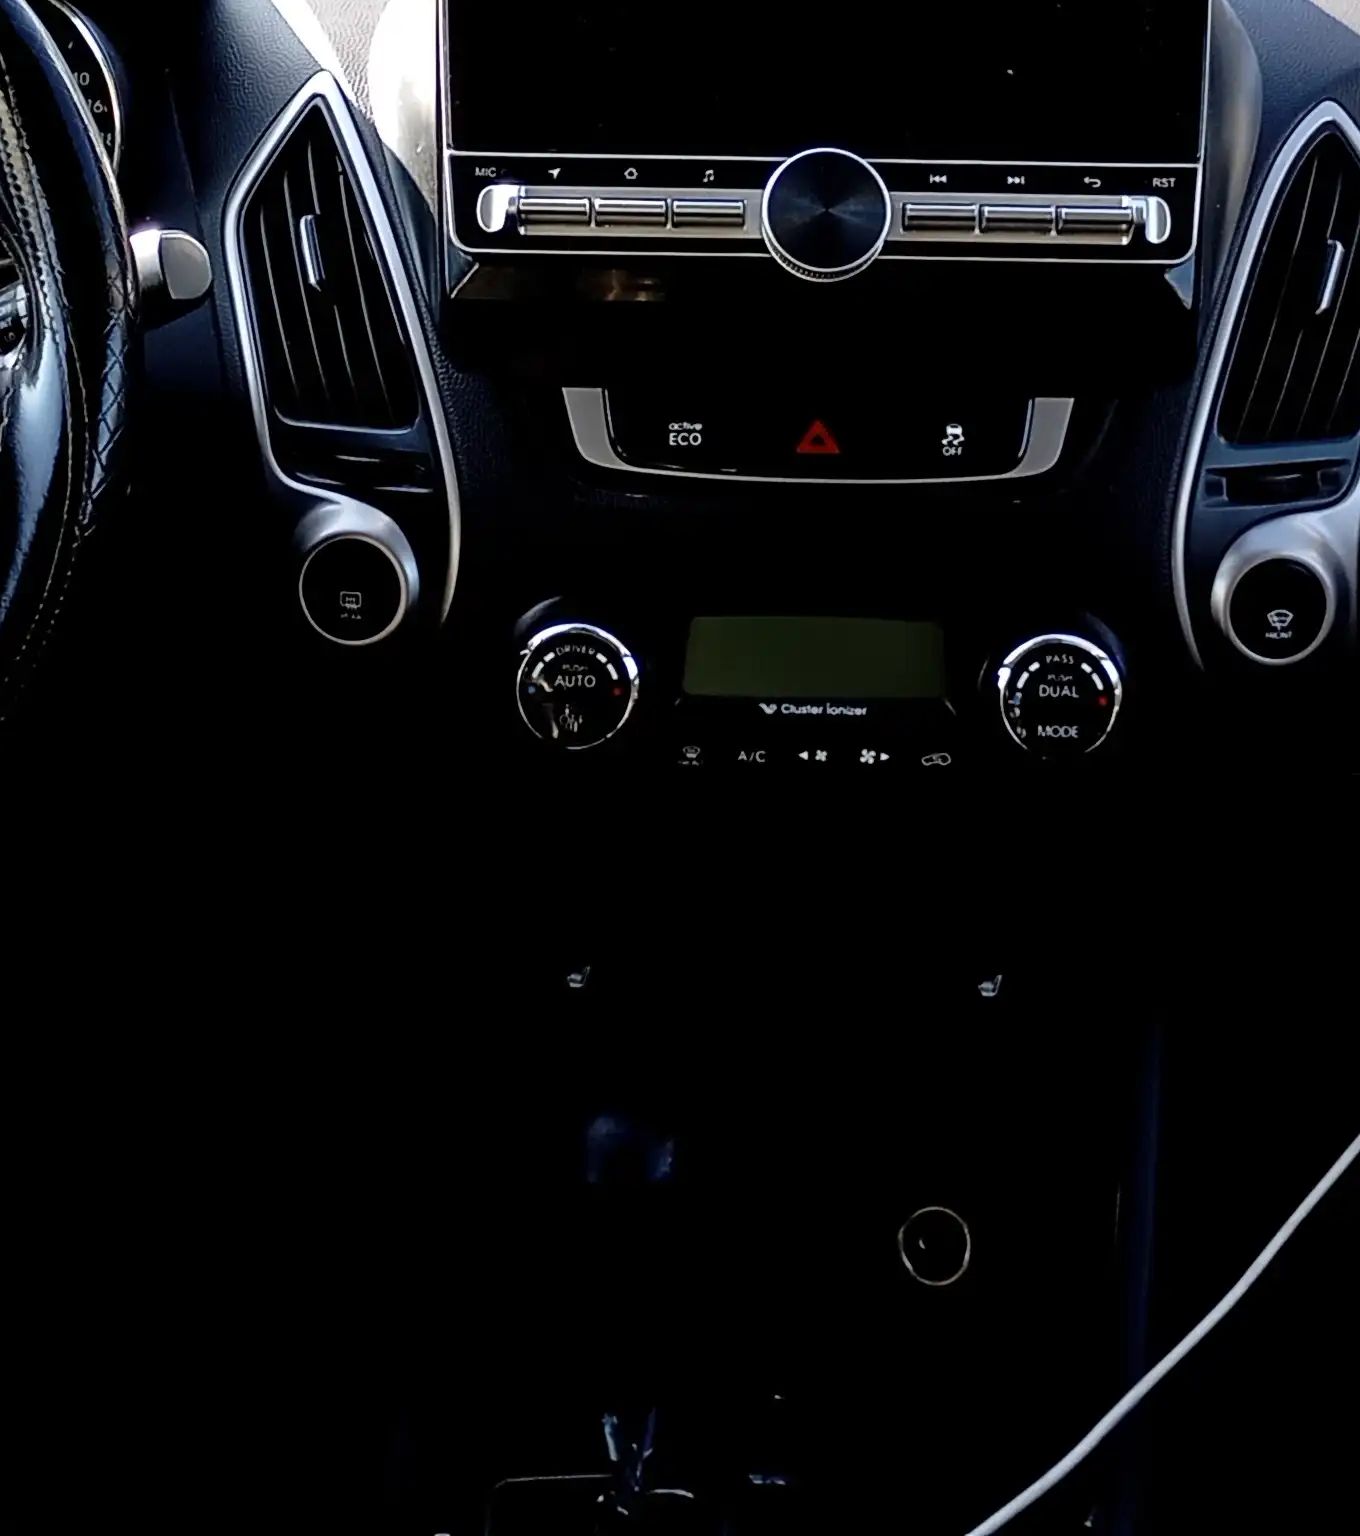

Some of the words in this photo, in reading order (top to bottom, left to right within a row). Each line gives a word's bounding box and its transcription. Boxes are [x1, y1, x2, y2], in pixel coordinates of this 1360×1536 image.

[474, 166, 497, 178] MIC
[1152, 177, 1177, 189] RST
[668, 432, 702, 446] ECO
[555, 644, 596, 656] DRIVER
[1045, 654, 1075, 665] PASS
[554, 674, 597, 688] AUTO
[1038, 684, 1080, 698] DUAL
[781, 703, 824, 715] Cluster
[1037, 724, 1080, 739] MODE
[738, 750, 767, 763] A/C
